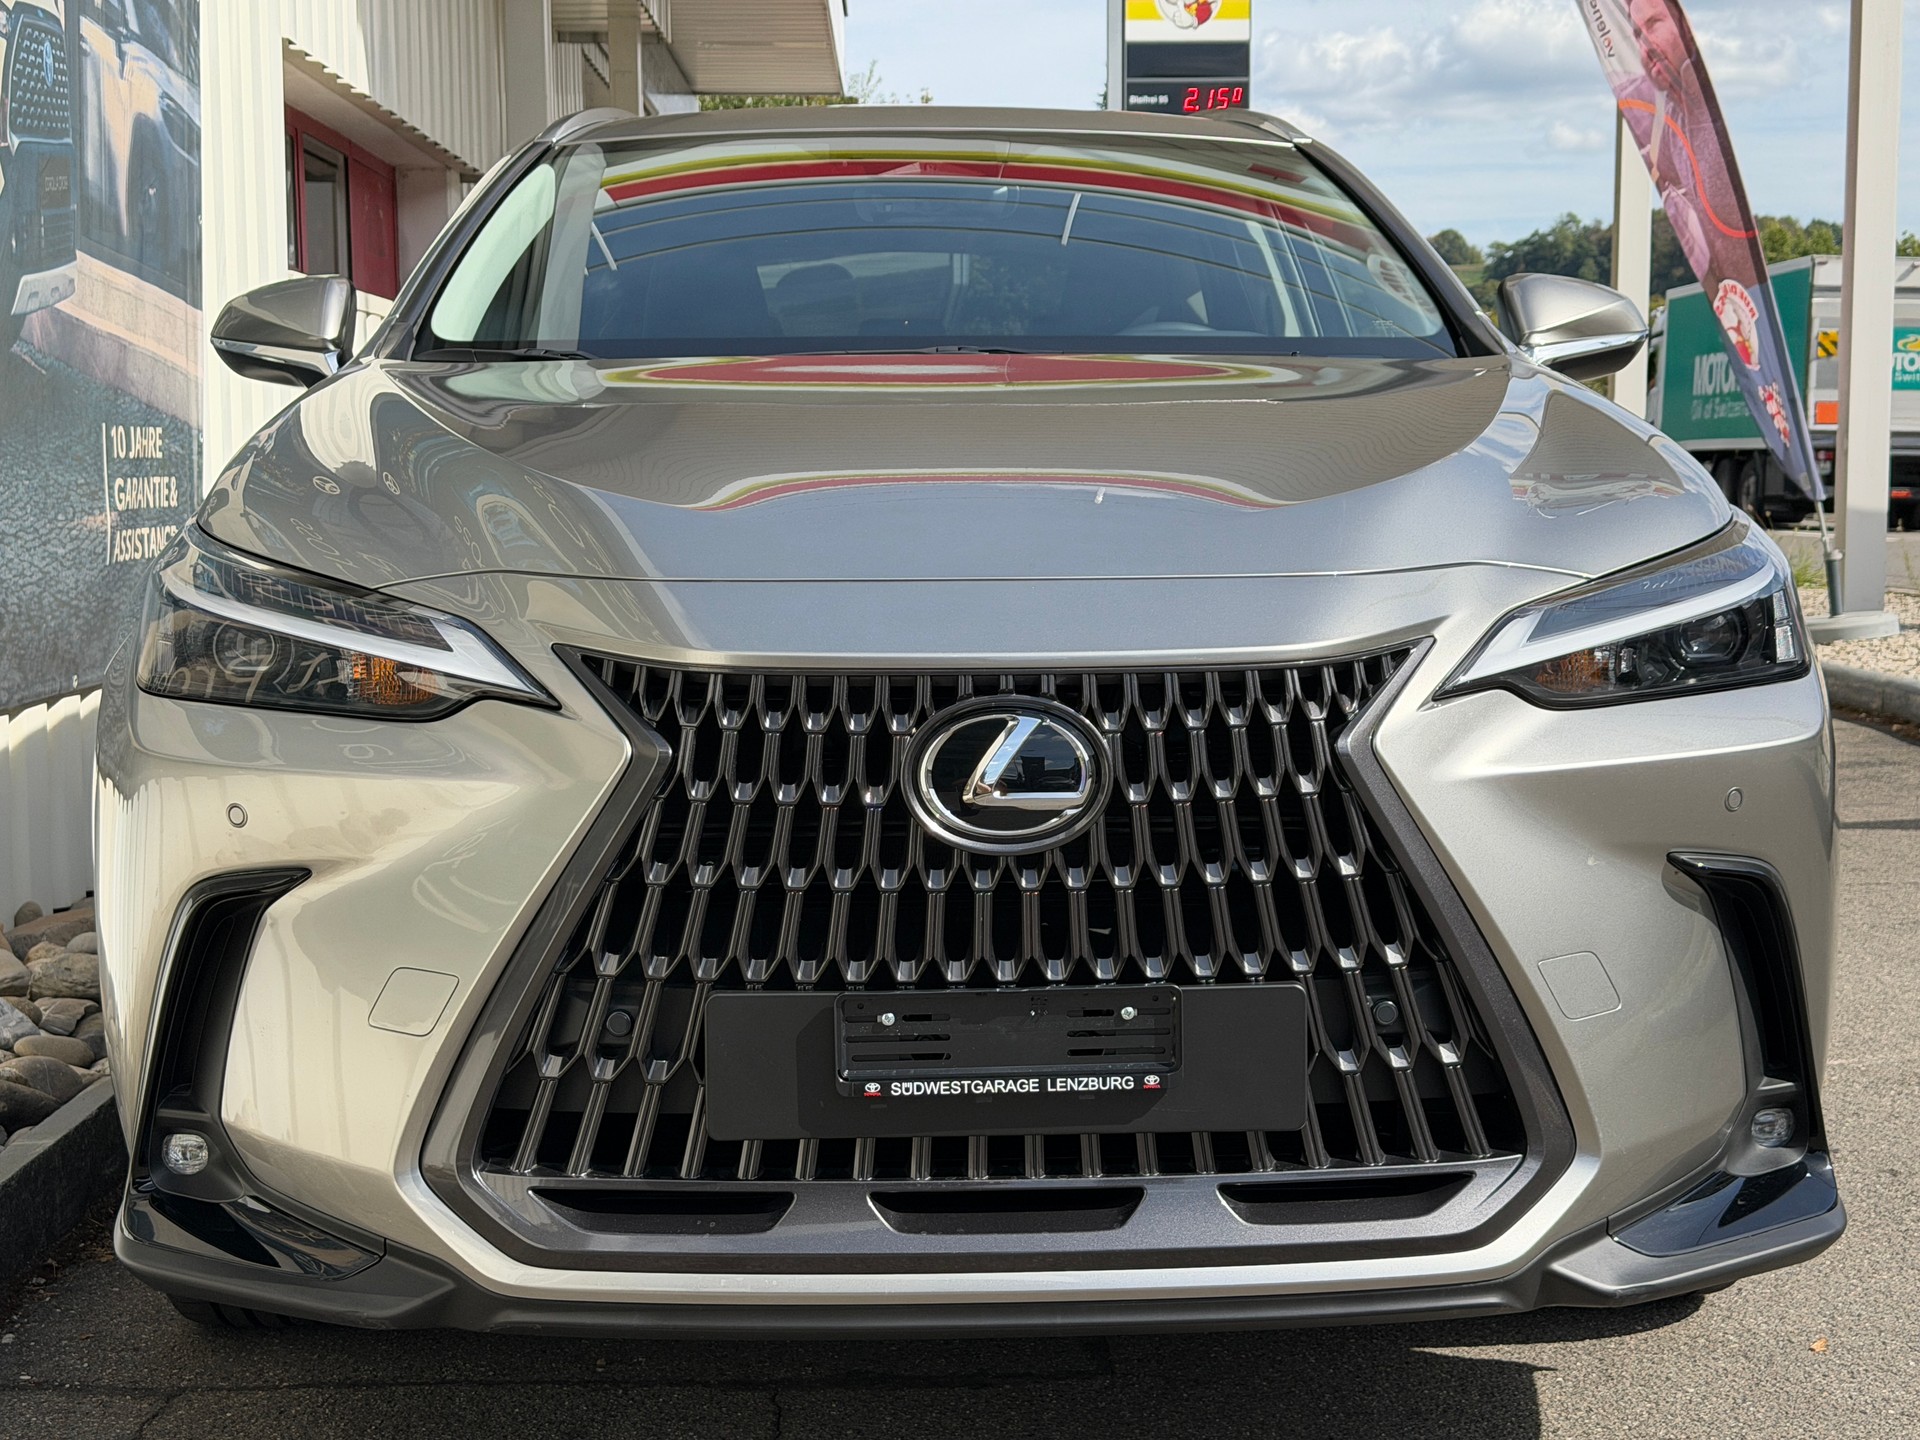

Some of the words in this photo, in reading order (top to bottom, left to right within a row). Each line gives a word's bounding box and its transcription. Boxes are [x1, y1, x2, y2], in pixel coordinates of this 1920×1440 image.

[111, 425, 126, 459] 10
[129, 426, 163, 459] JAHRE
[890, 1079, 1040, 1096] SÜDWESTGARAGE
[1047, 1075, 1135, 1092] LENZBURG
